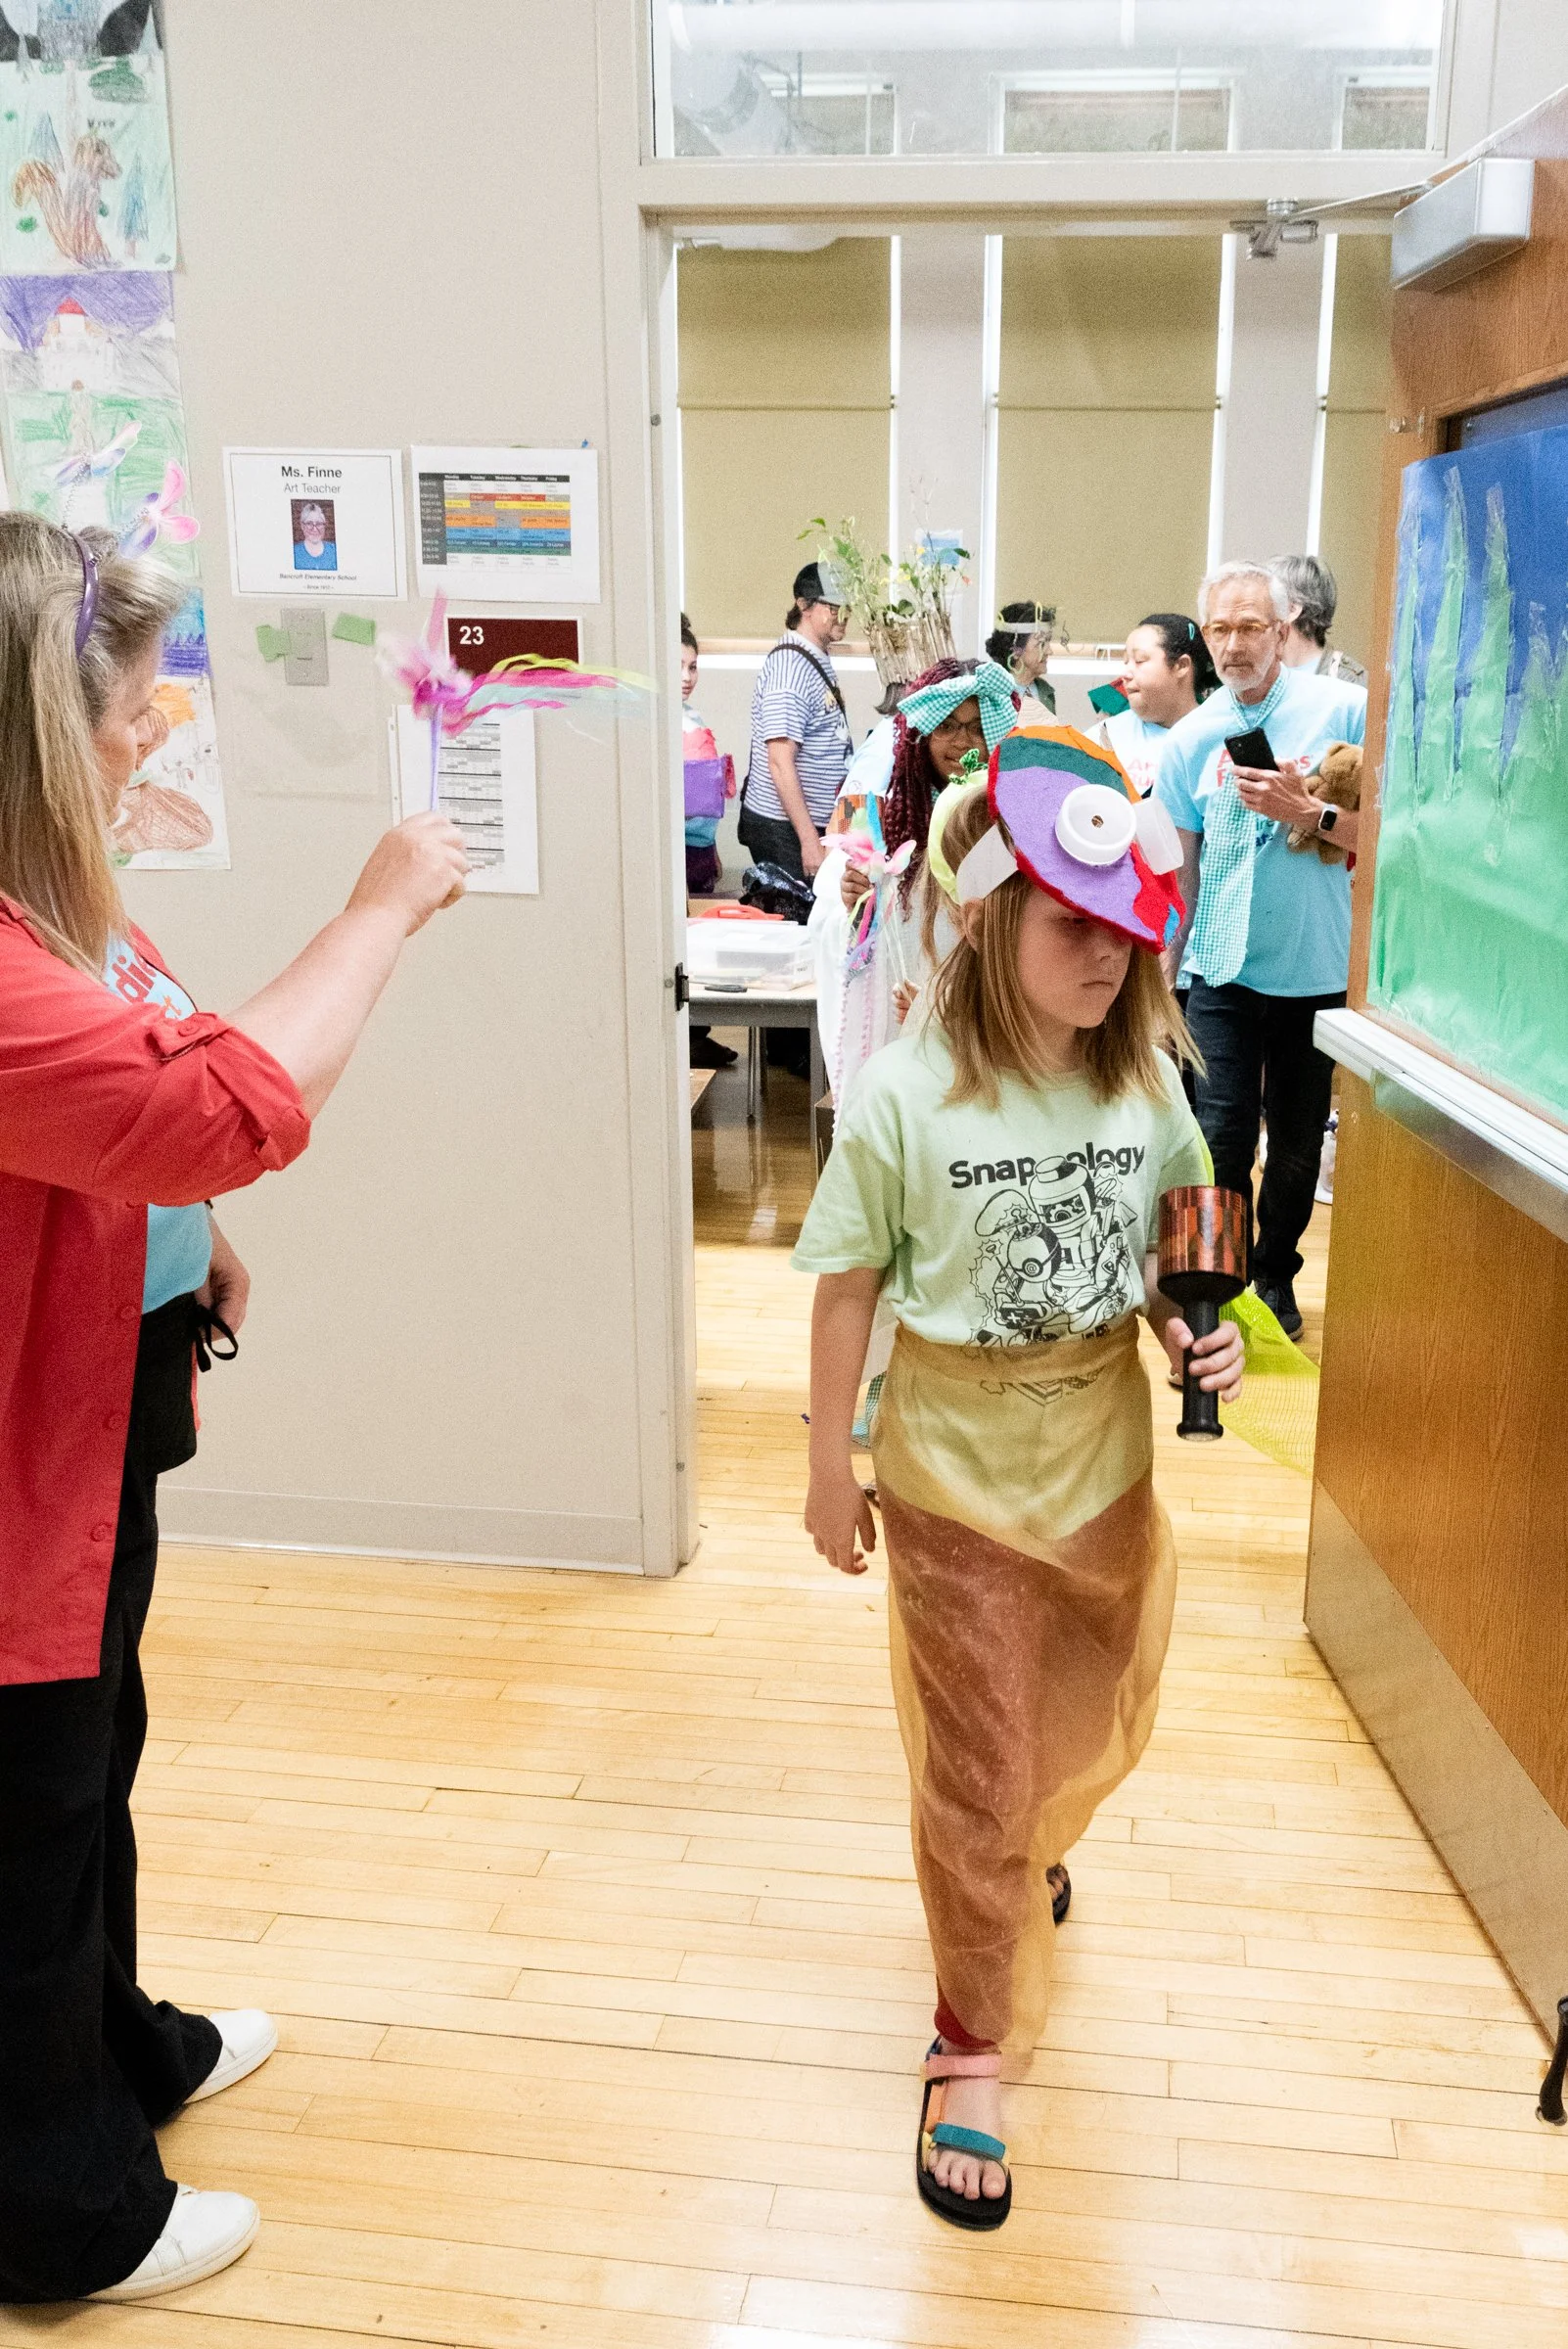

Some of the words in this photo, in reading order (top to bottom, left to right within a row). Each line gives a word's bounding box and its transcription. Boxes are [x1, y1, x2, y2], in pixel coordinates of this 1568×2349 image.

[281, 466, 303, 478] Ms.
[307, 466, 343, 479] Finne
[284, 483, 299, 493] Art
[301, 483, 342, 494] Teacher
[459, 625, 484, 645] 23
[948, 1141, 1145, 1189] Snapology
